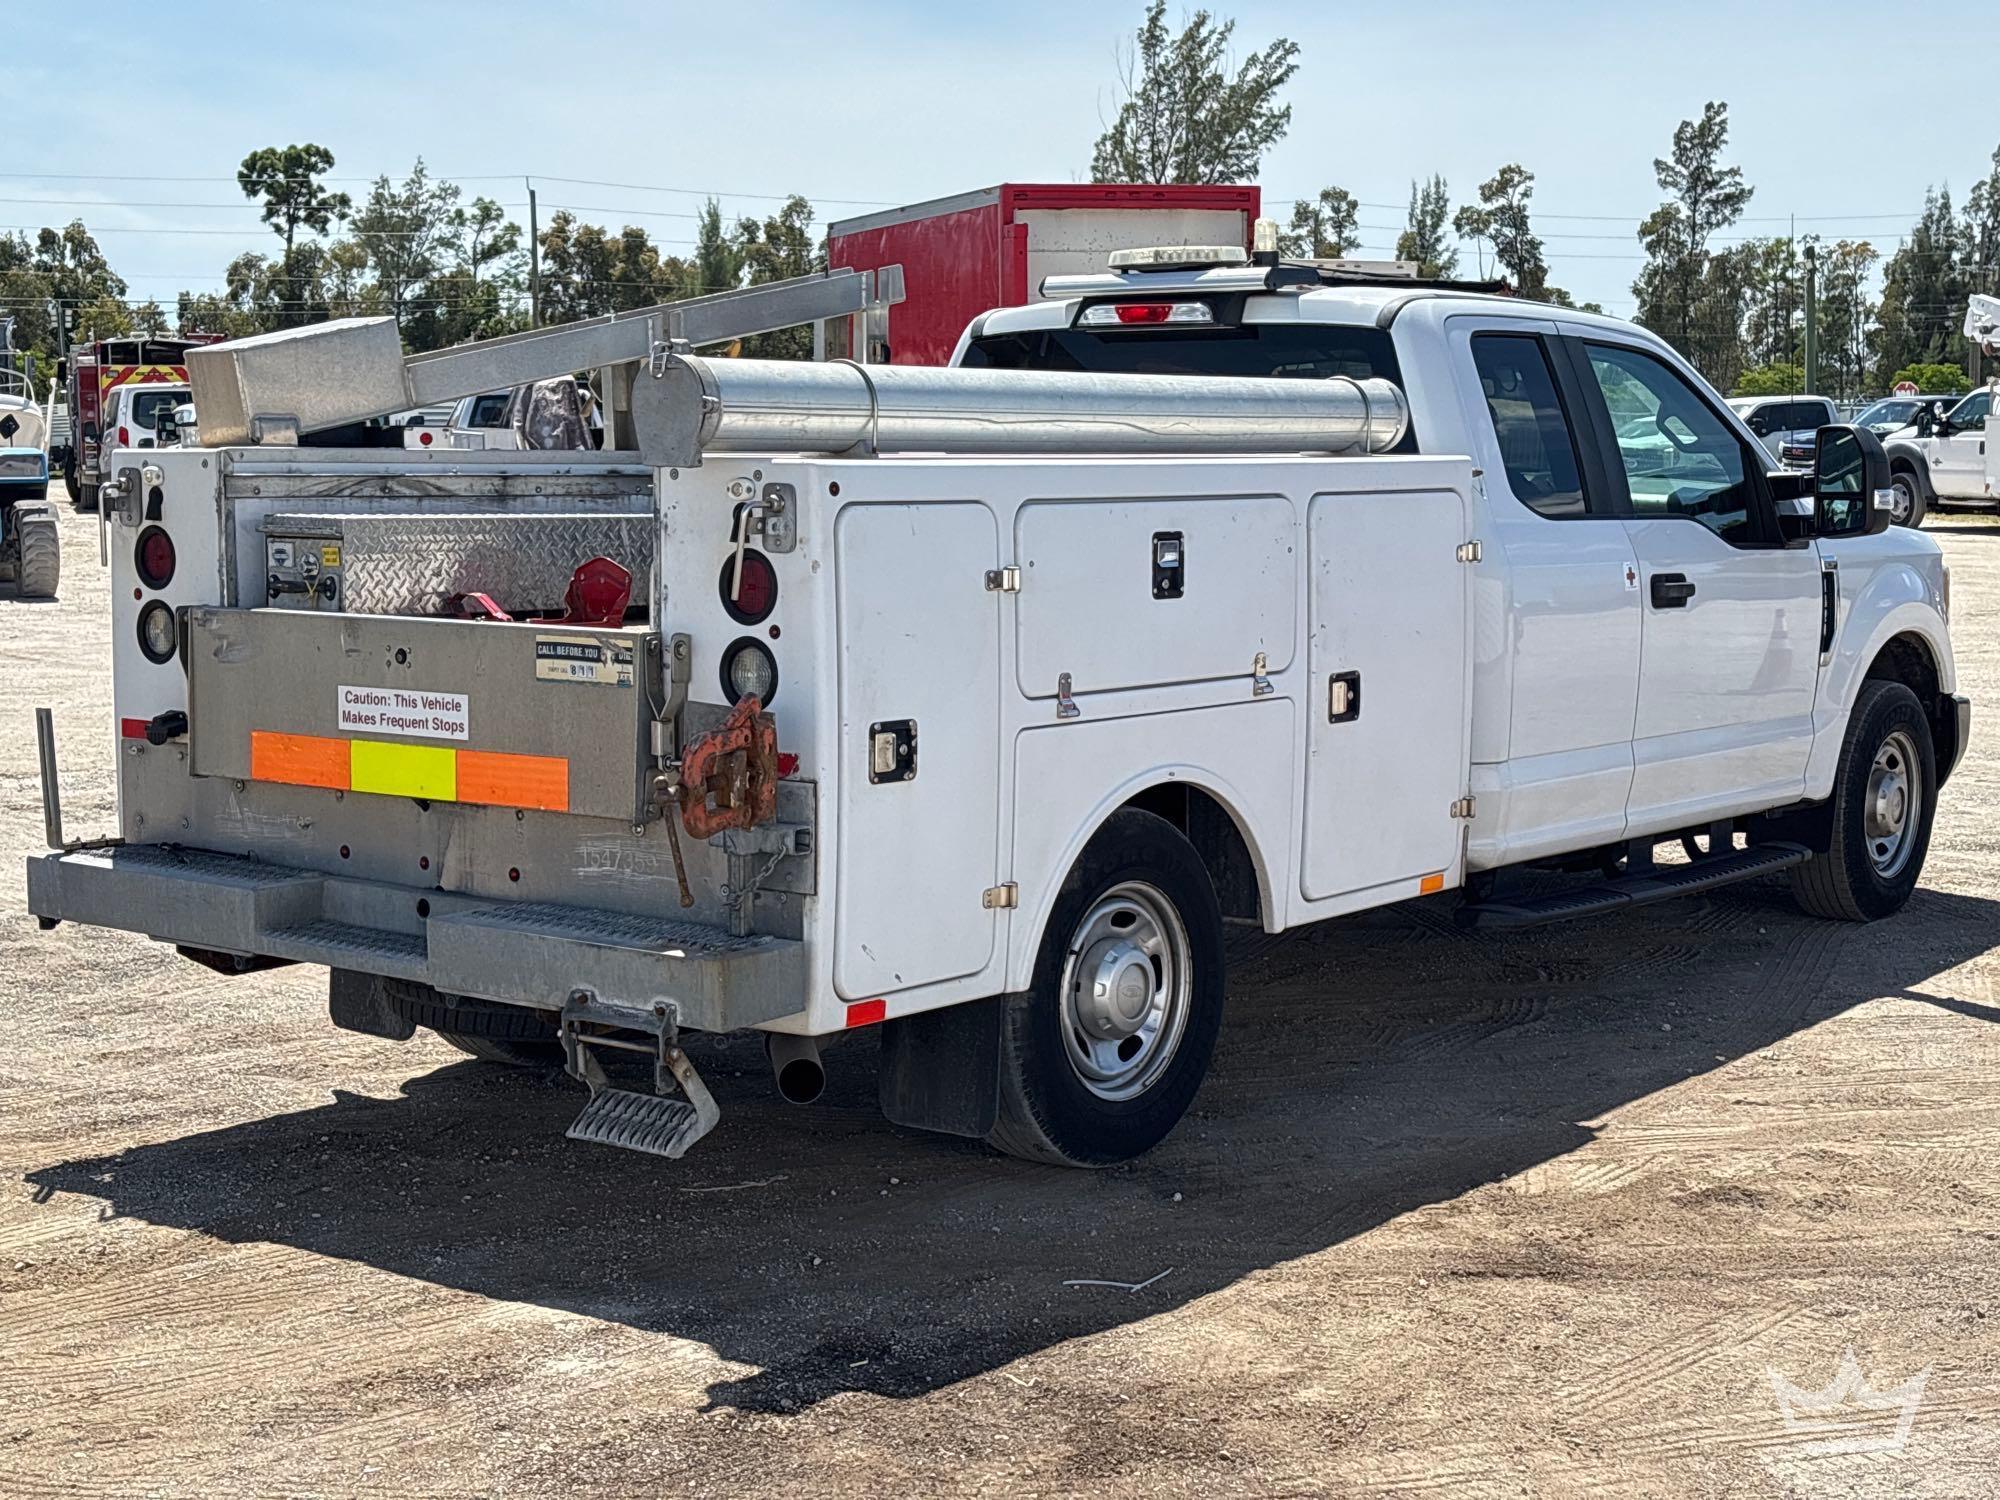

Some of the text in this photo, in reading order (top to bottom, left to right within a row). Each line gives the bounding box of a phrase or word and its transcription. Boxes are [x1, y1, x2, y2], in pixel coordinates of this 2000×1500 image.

[538, 645, 554, 654] CALL
[557, 646, 583, 657] BEFORE
[585, 648, 598, 658] YOU
[344, 690, 462, 713] Caution: This Vehicle
[342, 709, 465, 735] Makes Frequent Stops
